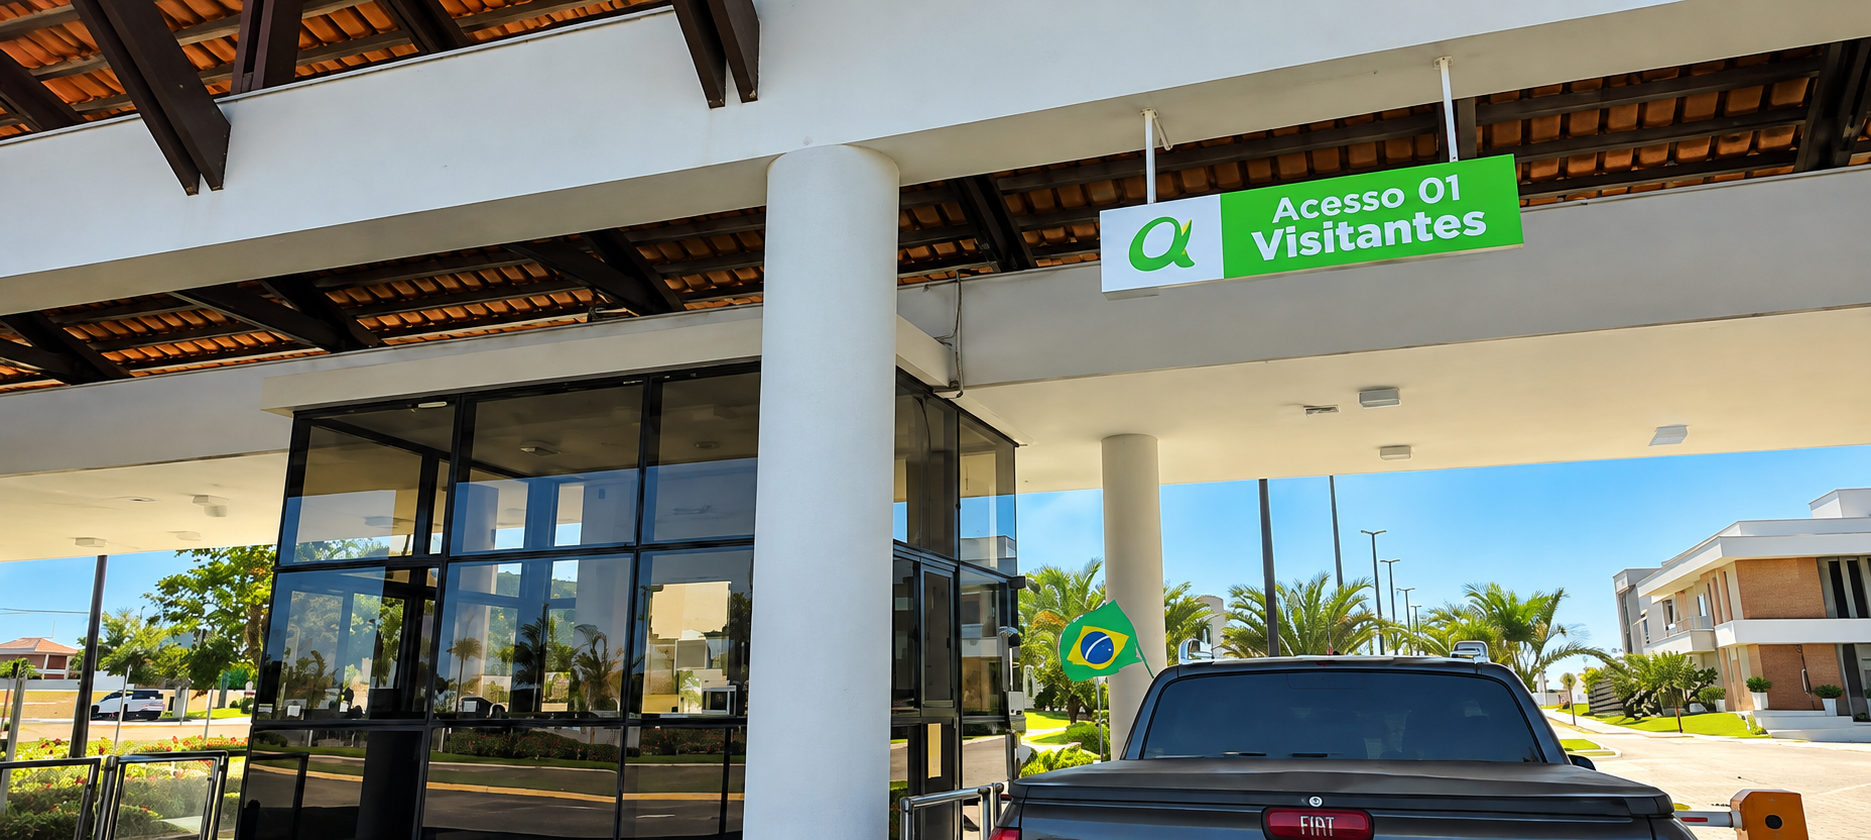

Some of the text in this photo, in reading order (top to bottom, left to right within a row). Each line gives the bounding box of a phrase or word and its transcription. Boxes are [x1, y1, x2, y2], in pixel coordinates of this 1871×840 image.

[1272, 174, 1461, 224] Acesso 01
[1251, 210, 1487, 261] Visitantes
[1300, 815, 1334, 837] FIAT
